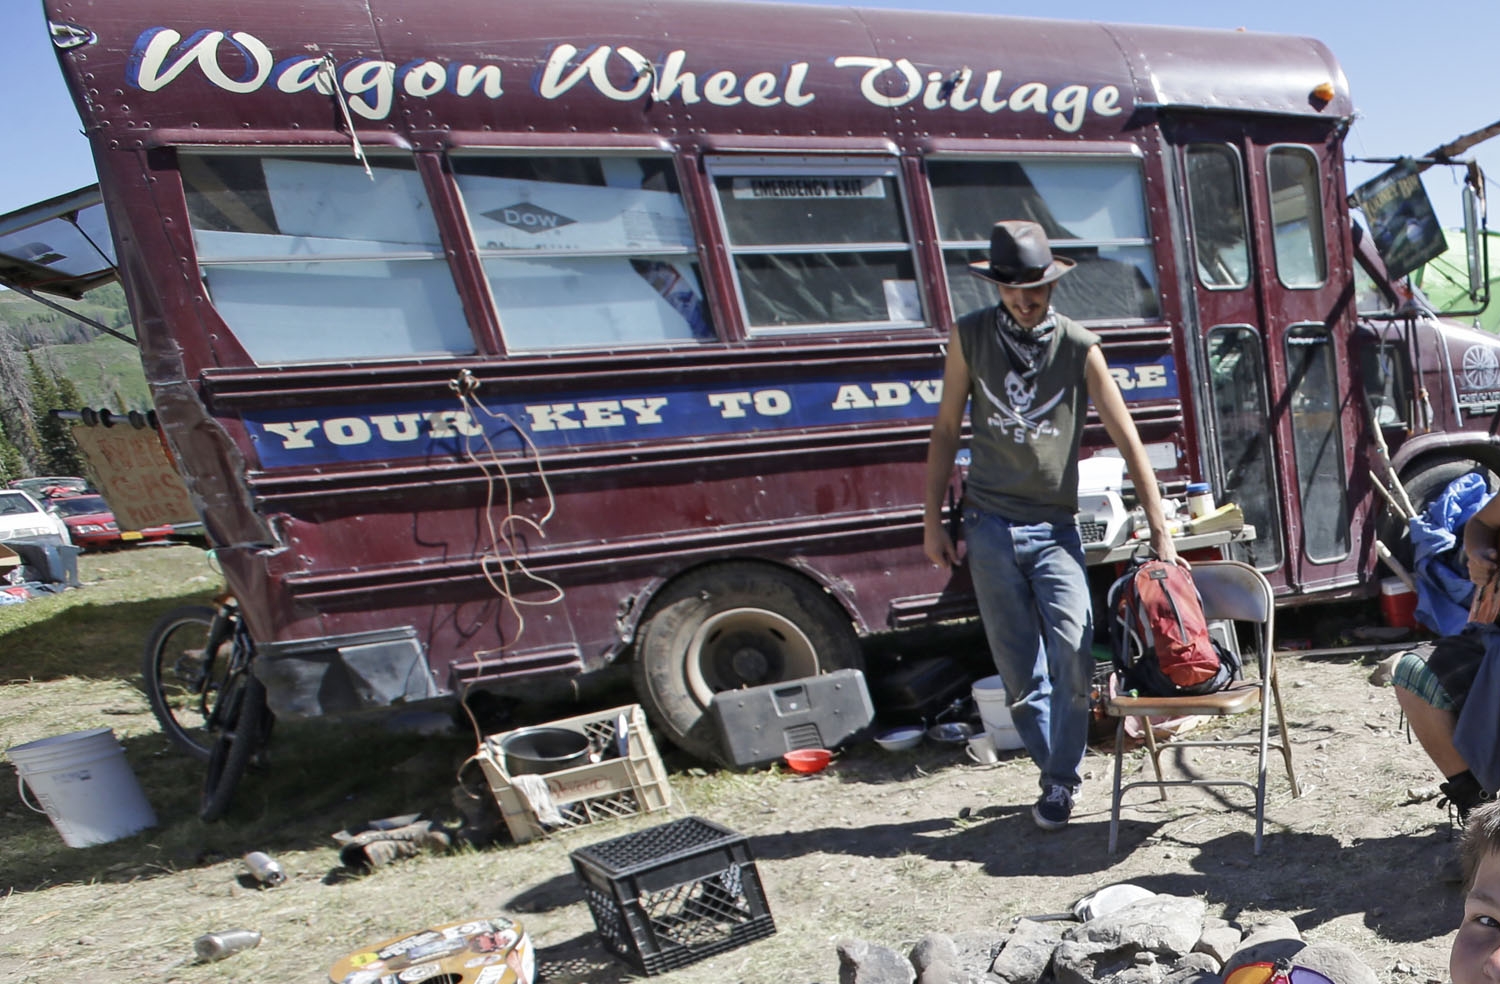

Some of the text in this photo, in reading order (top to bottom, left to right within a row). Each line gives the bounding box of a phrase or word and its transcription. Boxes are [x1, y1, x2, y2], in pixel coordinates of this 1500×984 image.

[131, 27, 1123, 133] Wagon Wheel Village
[751, 179, 863, 197] EMERGENCY EXIT
[263, 364, 1167, 450] YOUR KEY TO ADVRE
[111, 472, 188, 502] GAS
